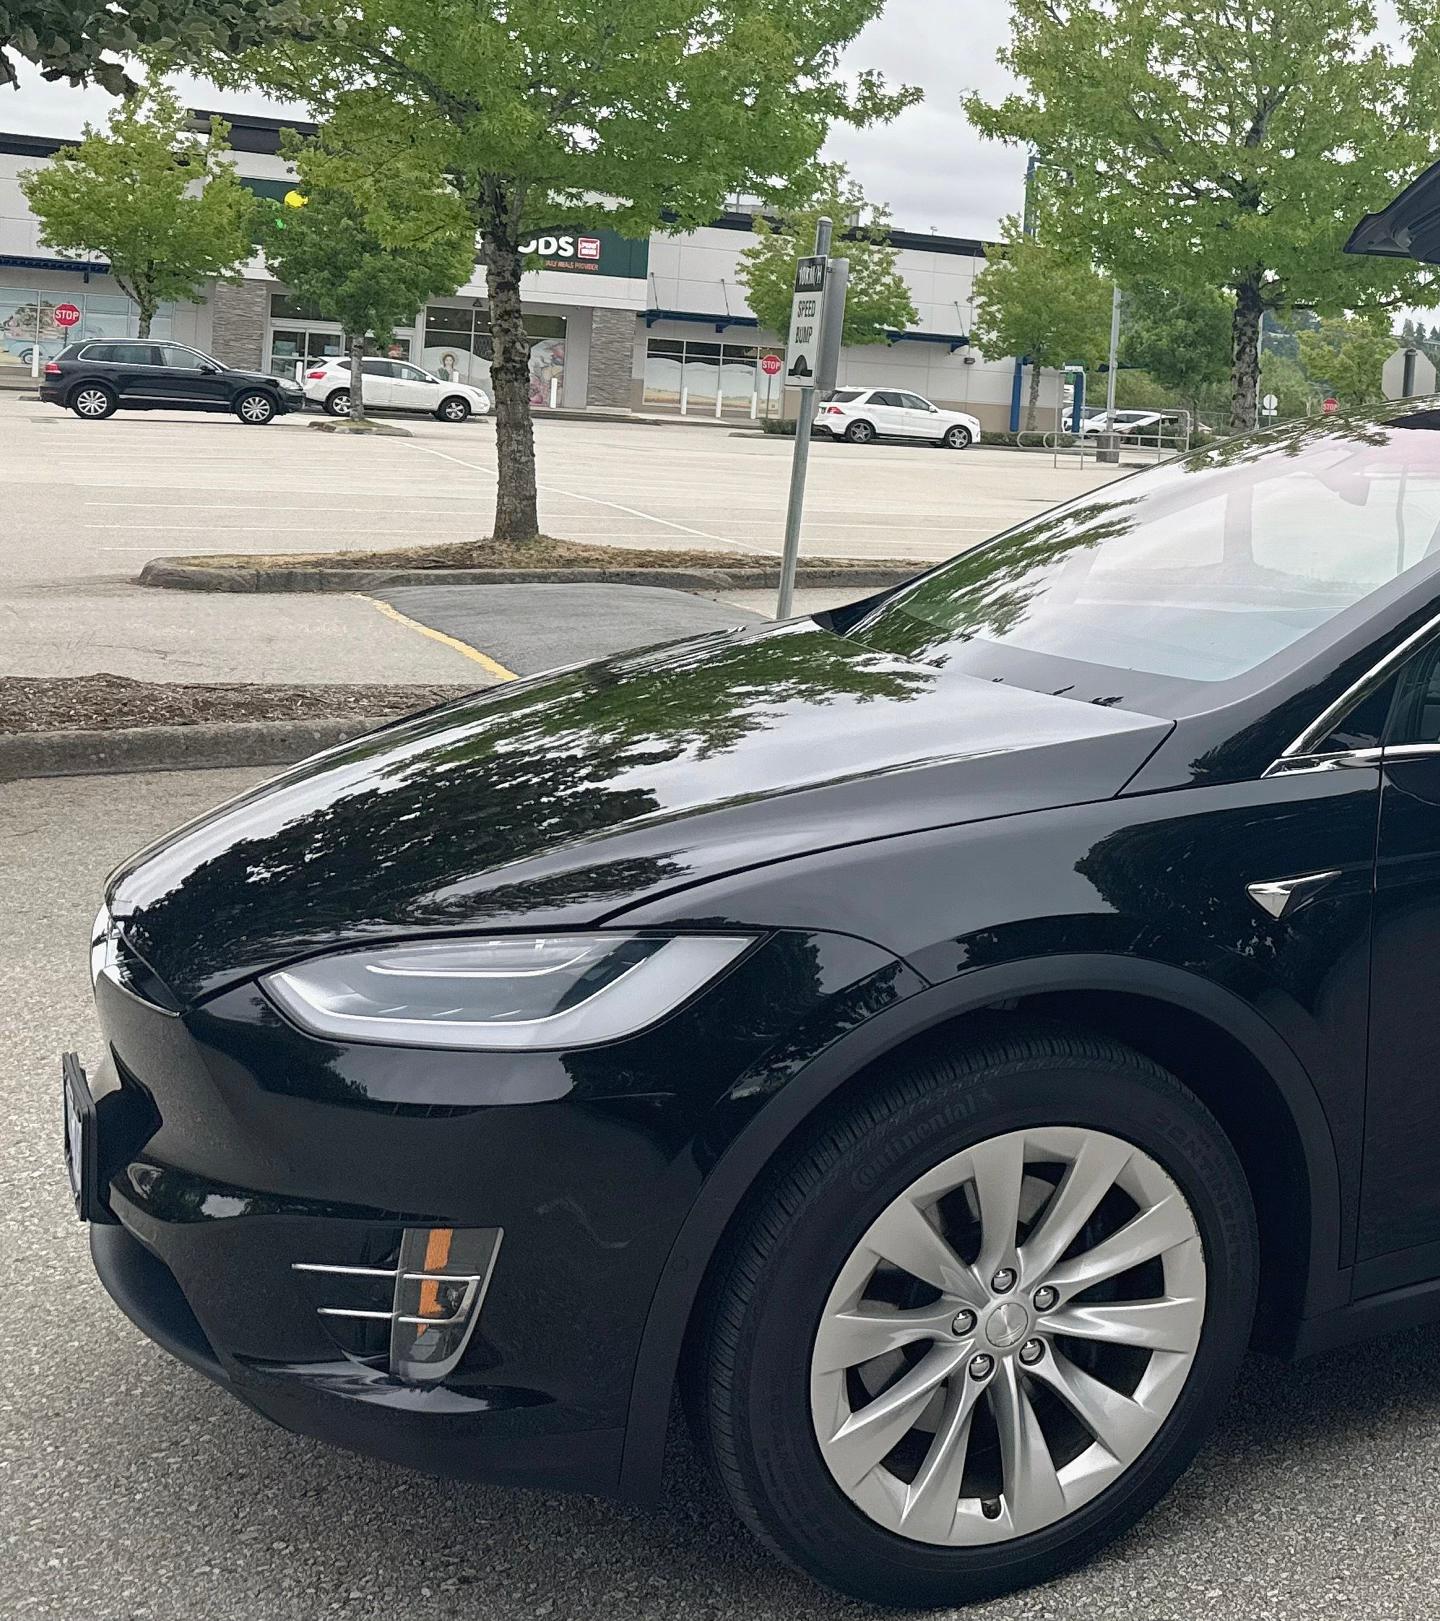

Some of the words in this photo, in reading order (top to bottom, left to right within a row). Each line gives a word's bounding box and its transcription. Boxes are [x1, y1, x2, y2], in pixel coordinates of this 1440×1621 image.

[517, 236, 574, 257] ODS
[55, 310, 80, 320] STOP
[798, 301, 815, 317] SPEED
[795, 326, 812, 343] BUMP
[762, 360, 780, 370] STOP
